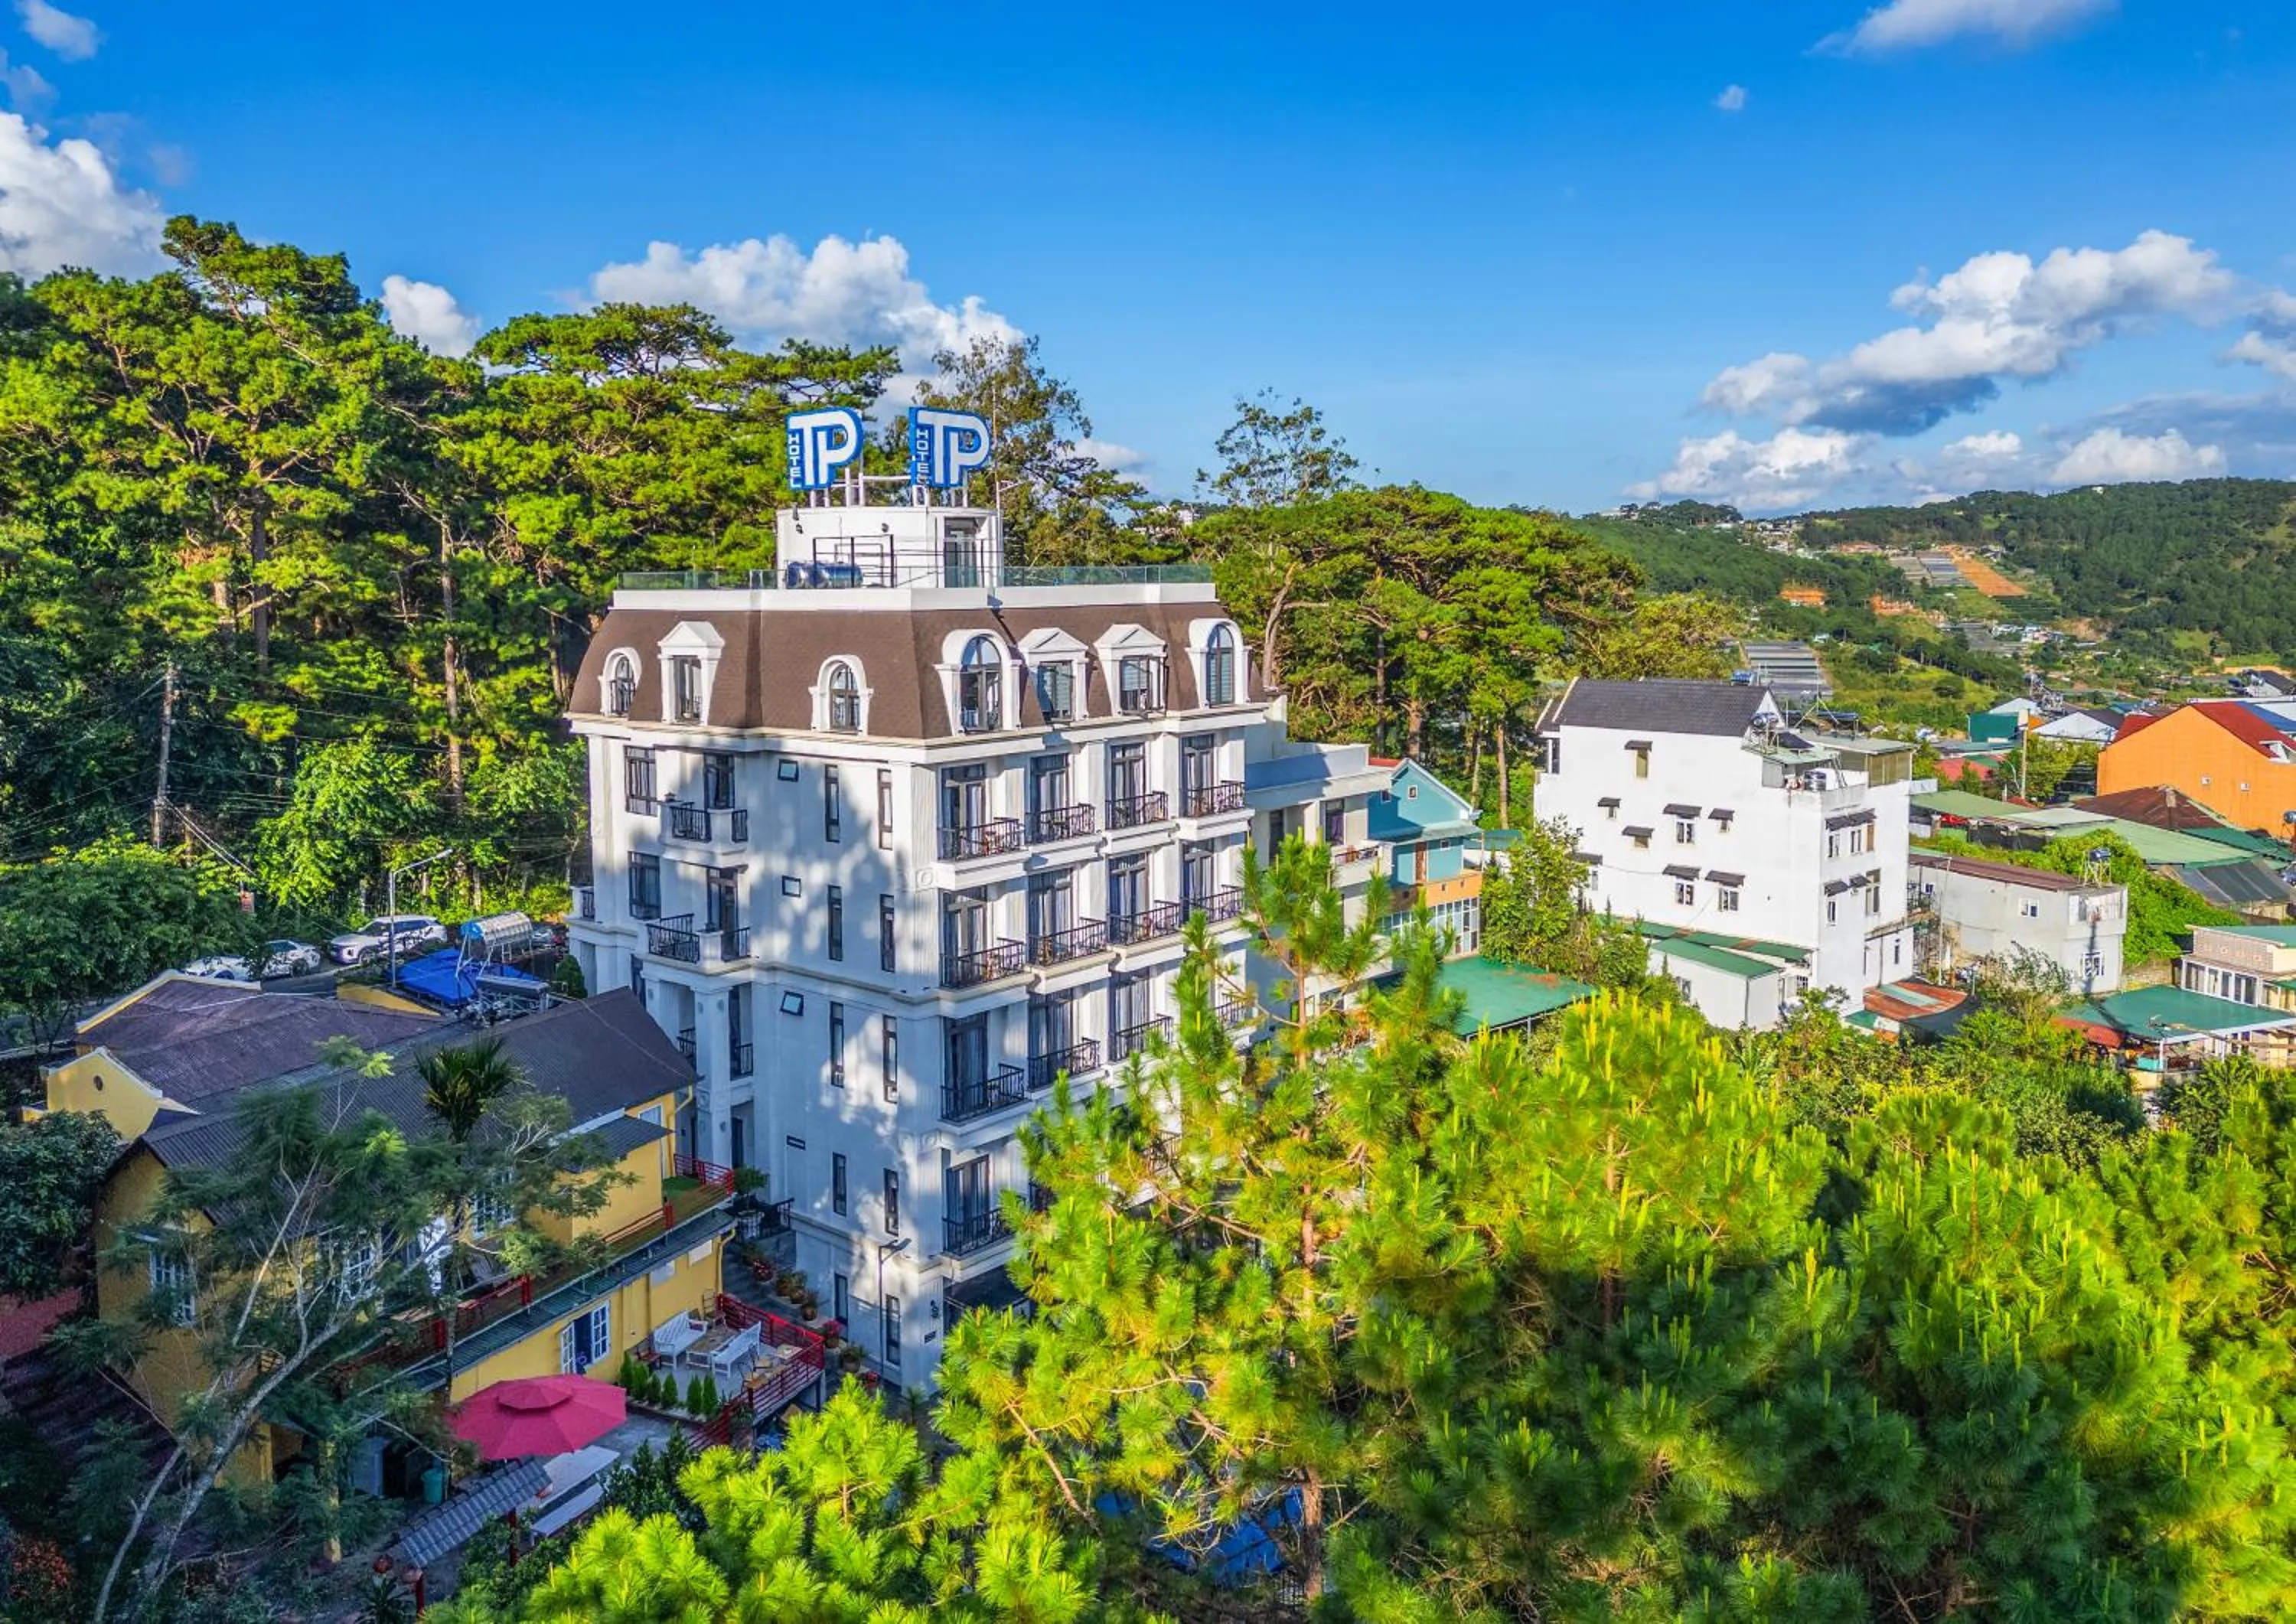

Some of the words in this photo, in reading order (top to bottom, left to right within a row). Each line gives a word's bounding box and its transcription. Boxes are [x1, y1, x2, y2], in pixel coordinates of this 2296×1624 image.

[788, 432, 801, 488] HOTEL
[789, 410, 857, 485] TP
[917, 409, 990, 484] TP
